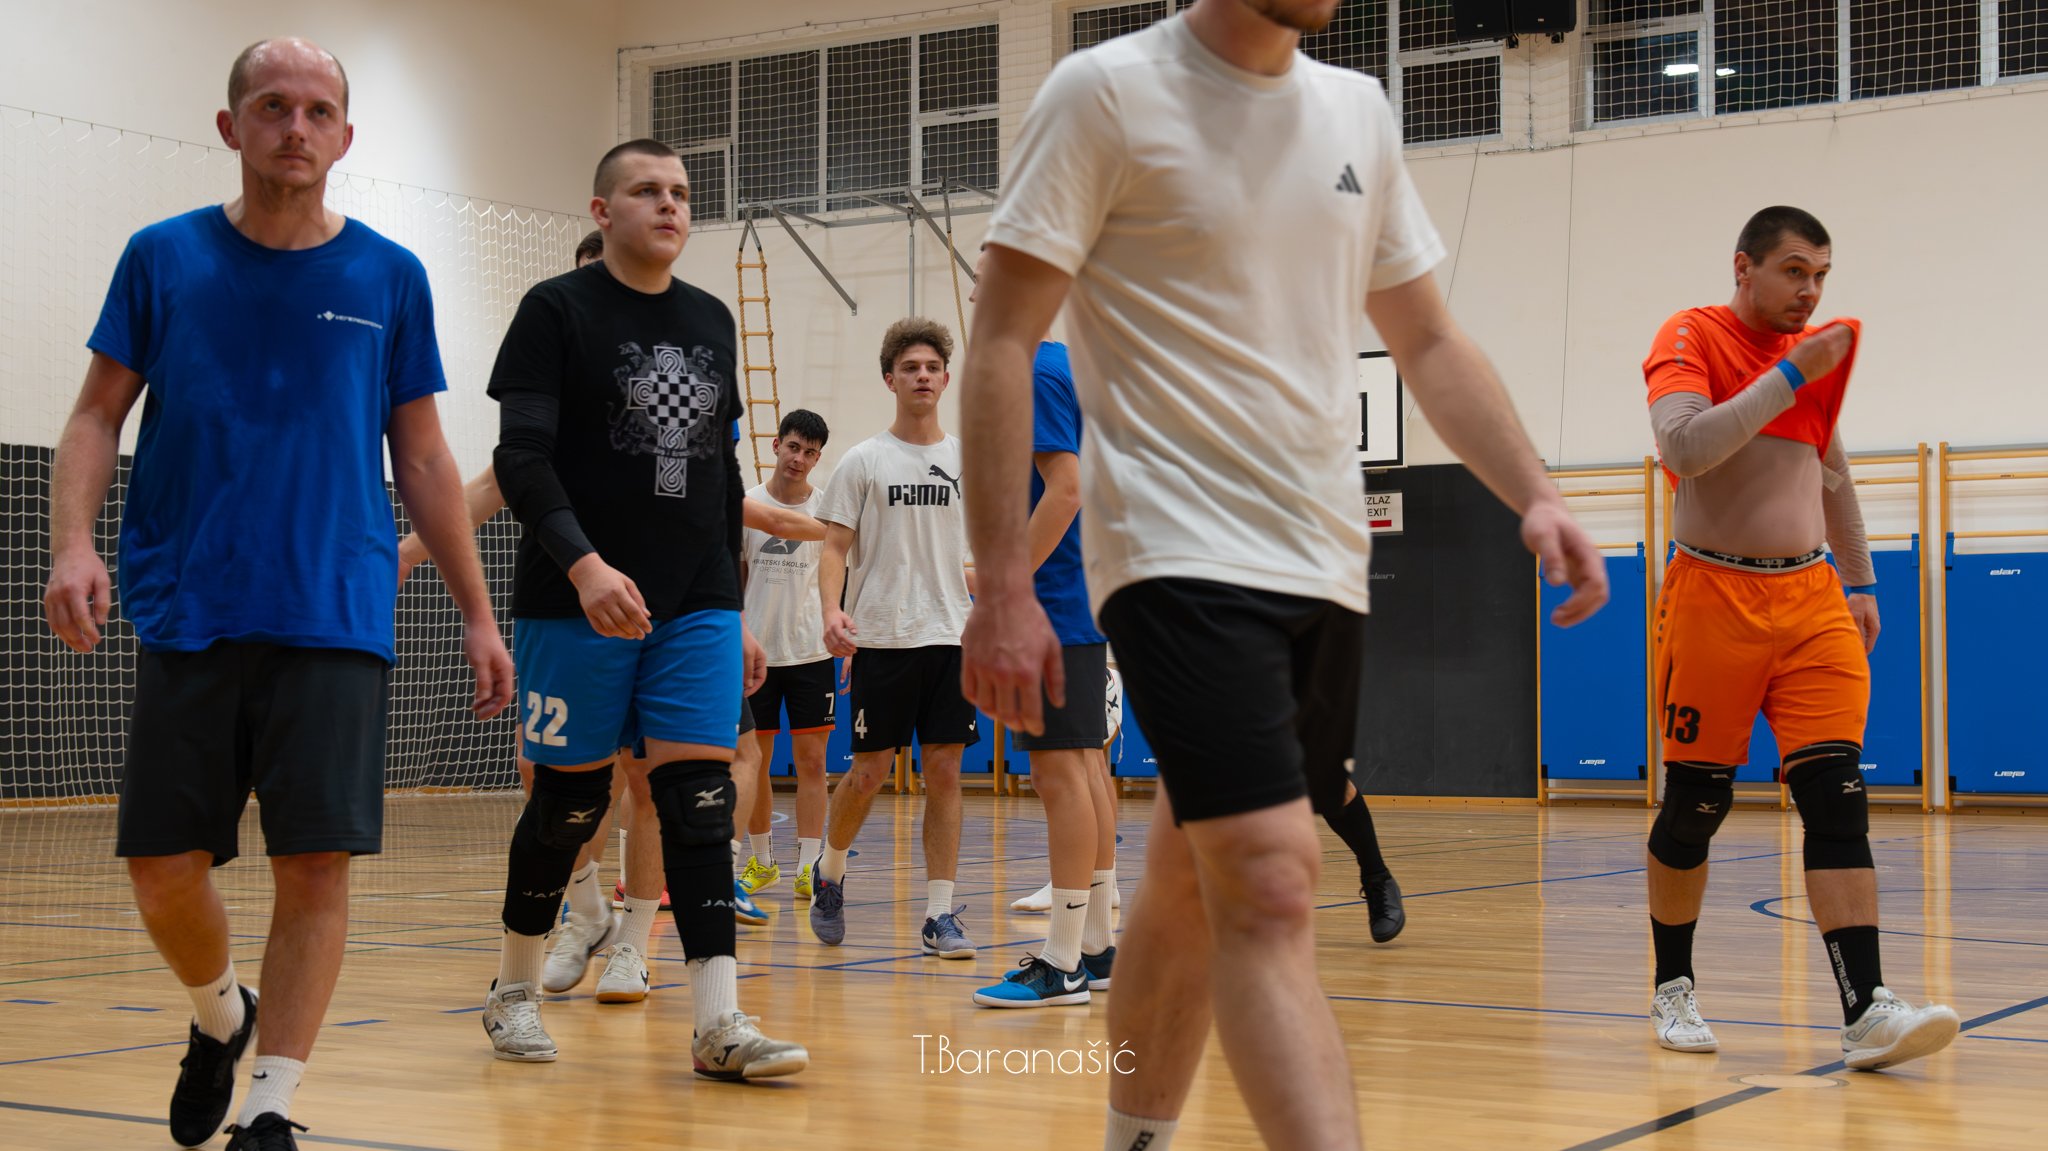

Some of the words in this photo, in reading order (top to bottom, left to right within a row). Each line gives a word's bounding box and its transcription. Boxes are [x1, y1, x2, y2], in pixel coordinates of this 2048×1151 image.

[888, 484, 950, 506] PUMA
[1364, 496, 1391, 505] IZLAZ
[1367, 508, 1389, 517] EXIT
[825, 692, 835, 715] 7
[525, 691, 568, 747] 22
[855, 708, 868, 739] 4
[1665, 703, 1700, 744] 13
